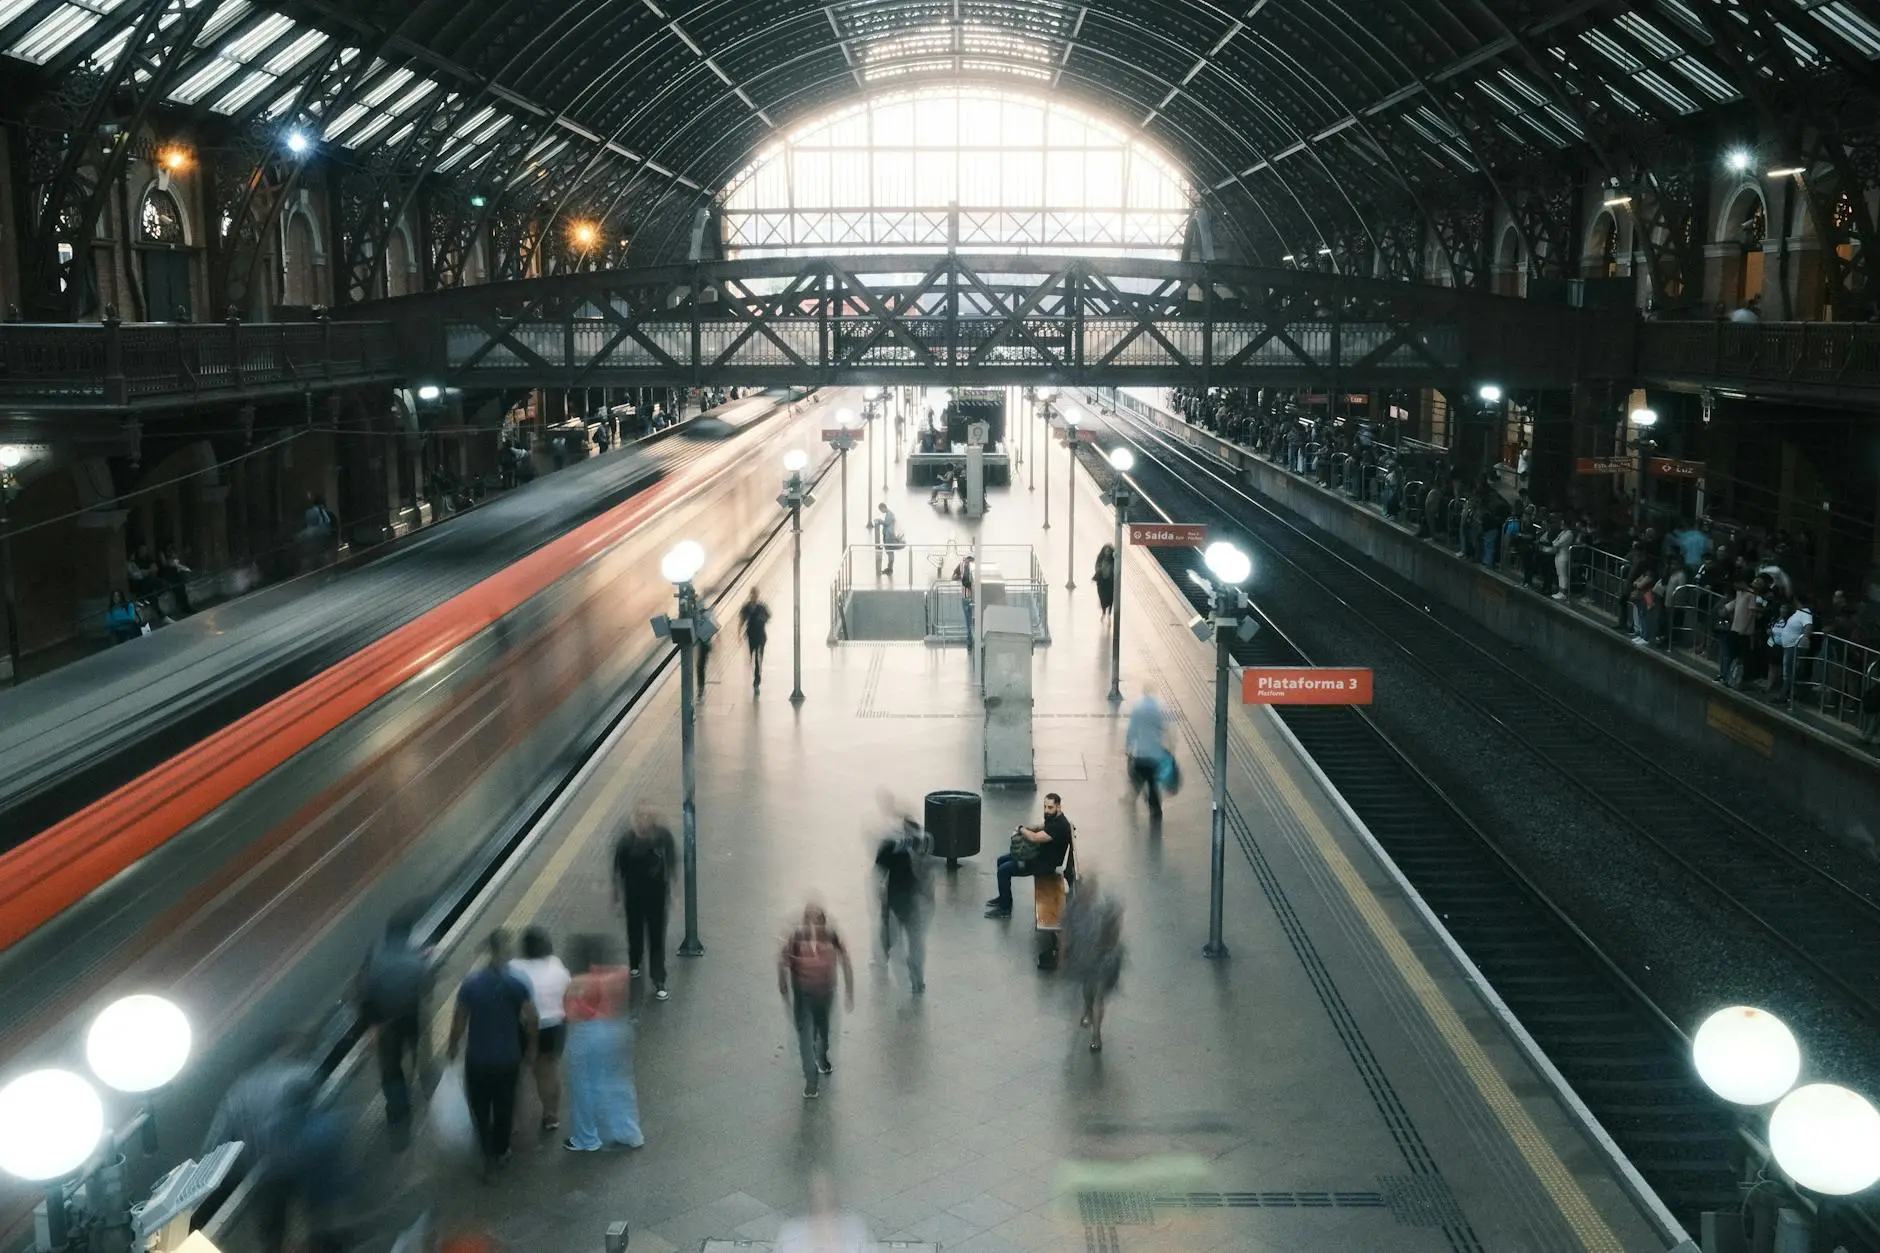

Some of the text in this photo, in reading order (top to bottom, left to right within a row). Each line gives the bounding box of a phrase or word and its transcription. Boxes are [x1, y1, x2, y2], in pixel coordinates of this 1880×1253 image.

[1145, 531, 1174, 540] Saída
[1258, 677, 1358, 690] Plataforma 3
